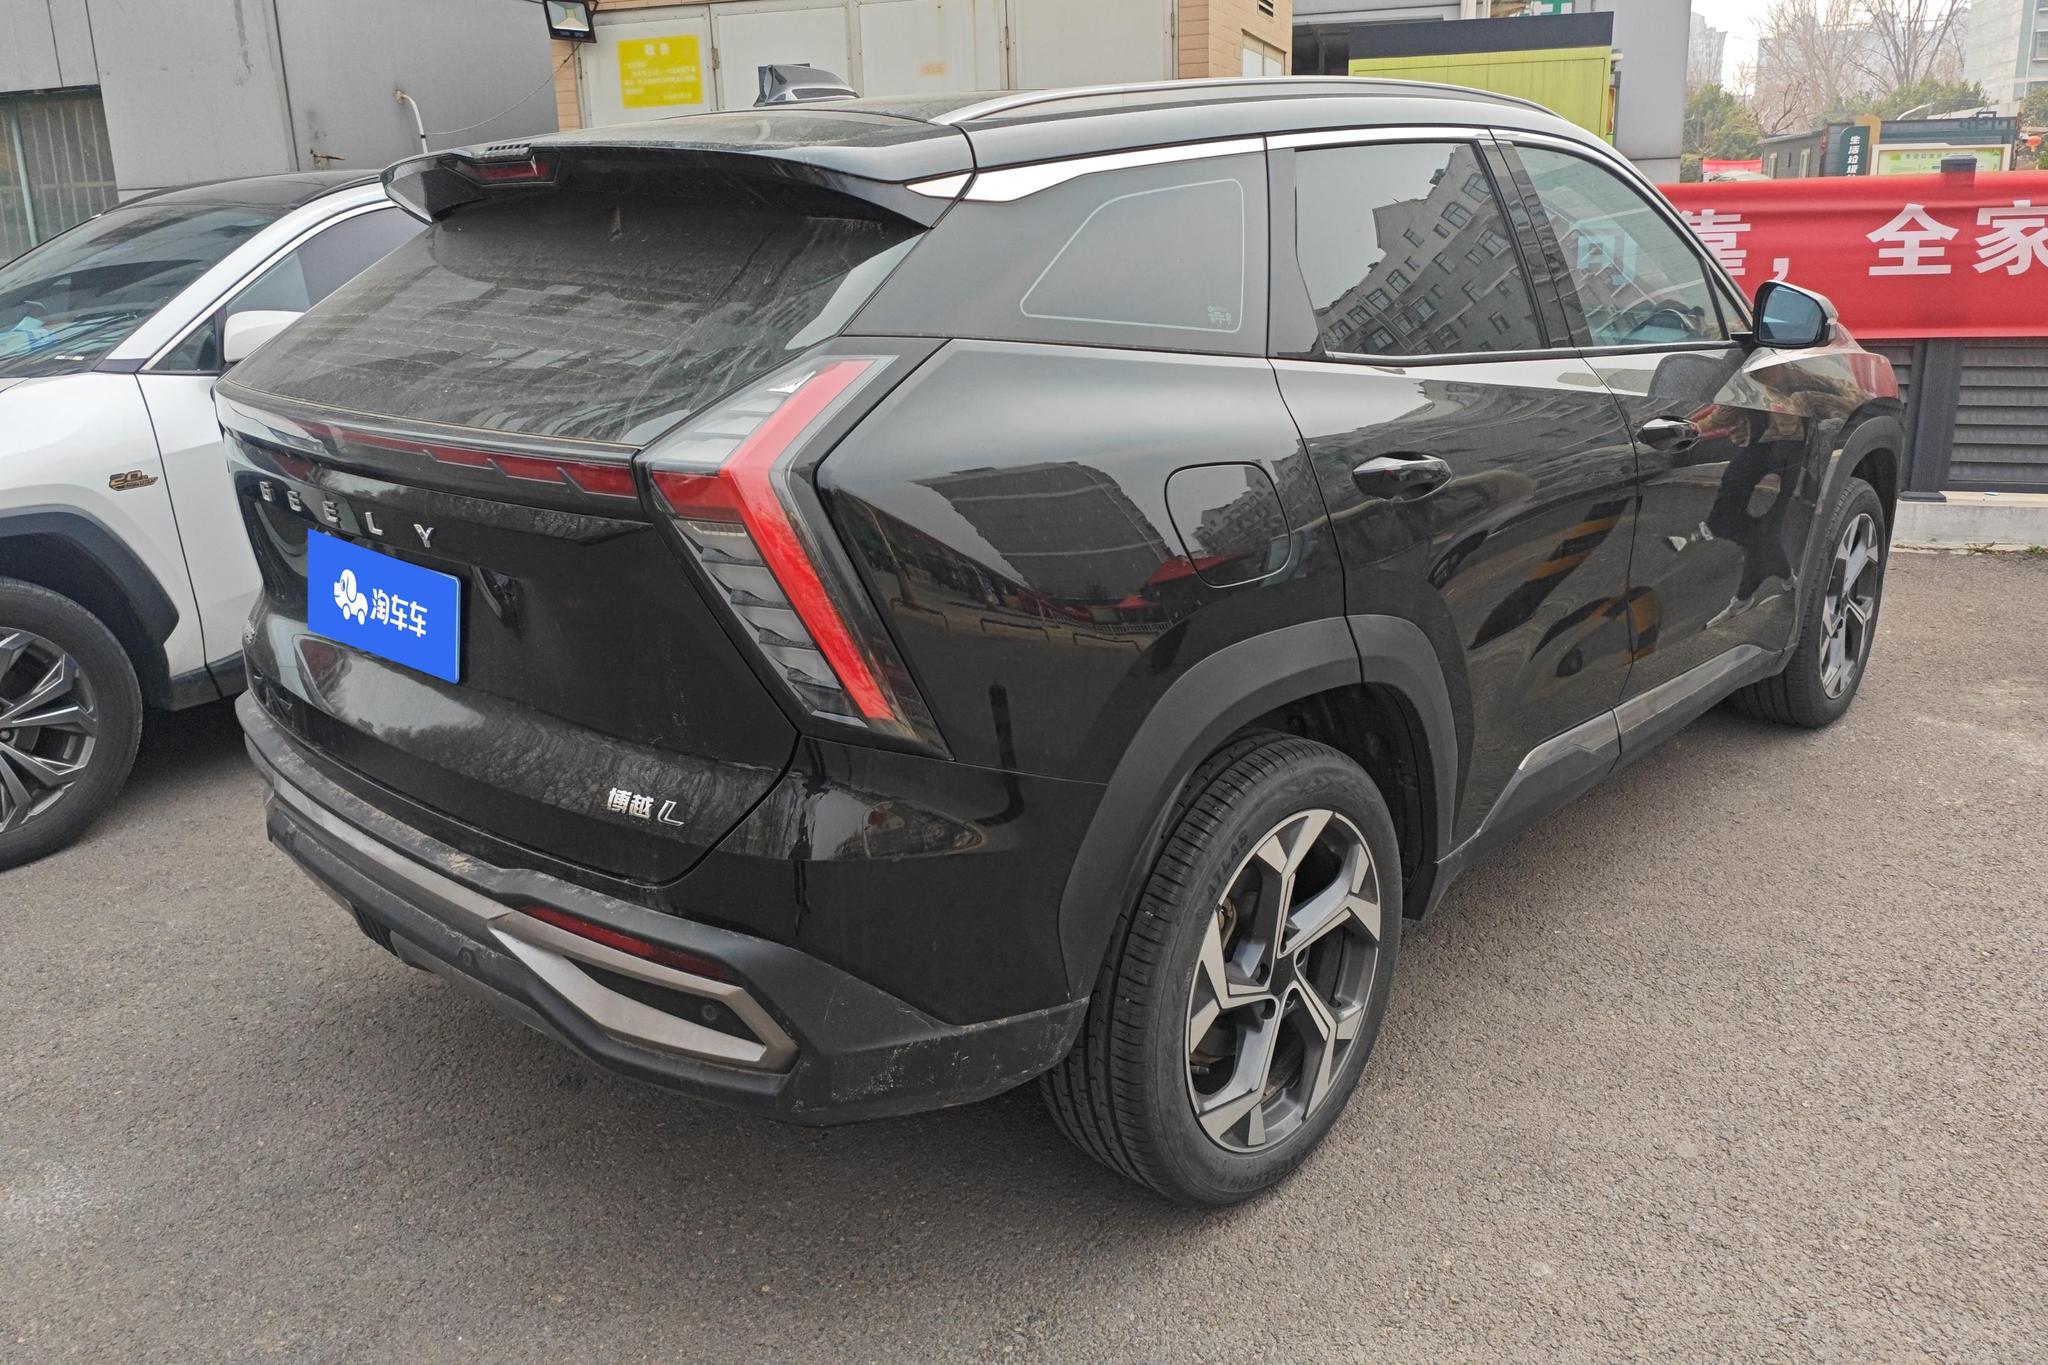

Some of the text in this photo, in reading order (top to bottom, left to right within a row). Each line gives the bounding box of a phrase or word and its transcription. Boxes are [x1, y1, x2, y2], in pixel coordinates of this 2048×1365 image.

[1846, 135, 1861, 177] 生活垃圾
[259, 481, 434, 548] GEELY
[606, 787, 685, 827] 博越 L
[1207, 833, 1248, 898] ATLAS
